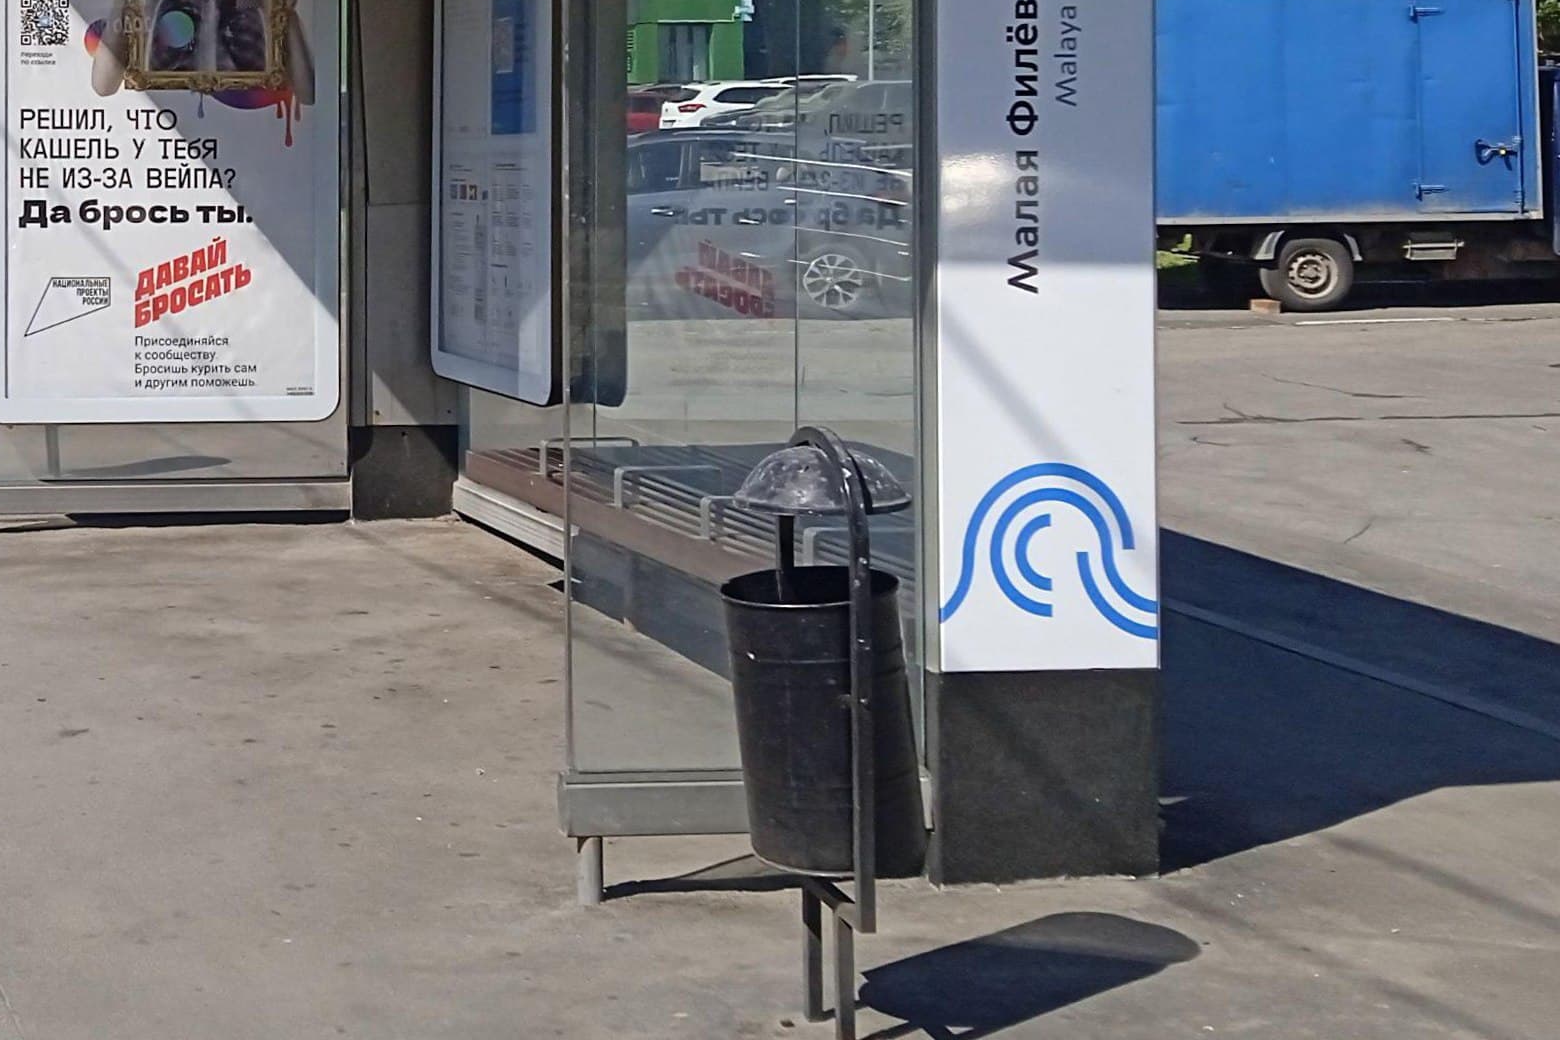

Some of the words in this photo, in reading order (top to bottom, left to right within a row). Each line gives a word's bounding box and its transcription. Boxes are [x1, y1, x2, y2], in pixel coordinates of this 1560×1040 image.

[1054, 4, 1083, 107] Malaya
[20, 109, 112, 132] РЕШИЛ,
[127, 109, 177, 130] ЧТО
[20, 138, 119, 159] КАШЕЛЬ
[132, 138, 145, 159] У
[20, 168, 49, 188] НЕ
[63, 168, 133, 189] ИЗ-ЗА
[147, 163, 236, 189] ВЕЙПА?
[18, 199, 71, 228] Да
[79, 199, 190, 230] брось
[196, 205, 253, 223] ты.
[1006, 150, 1039, 294] Малая
[135, 236, 226, 301] ДАВАЙ
[52, 279, 108, 288] НАЦИОНАЛЬНЫЕ
[76, 288, 109, 296] ПРОЕКТЫ
[82, 296, 108, 305] РОССИИ
[135, 263, 252, 328] БРОСАТЬ
[135, 335, 229, 348] Присоединяйся
[135, 351, 140, 360] к
[135, 363, 188, 376] Бросишь
[191, 364, 231, 376] курить
[234, 364, 257, 373] сам
[135, 379, 142, 387] и
[145, 378, 187, 390] другим
